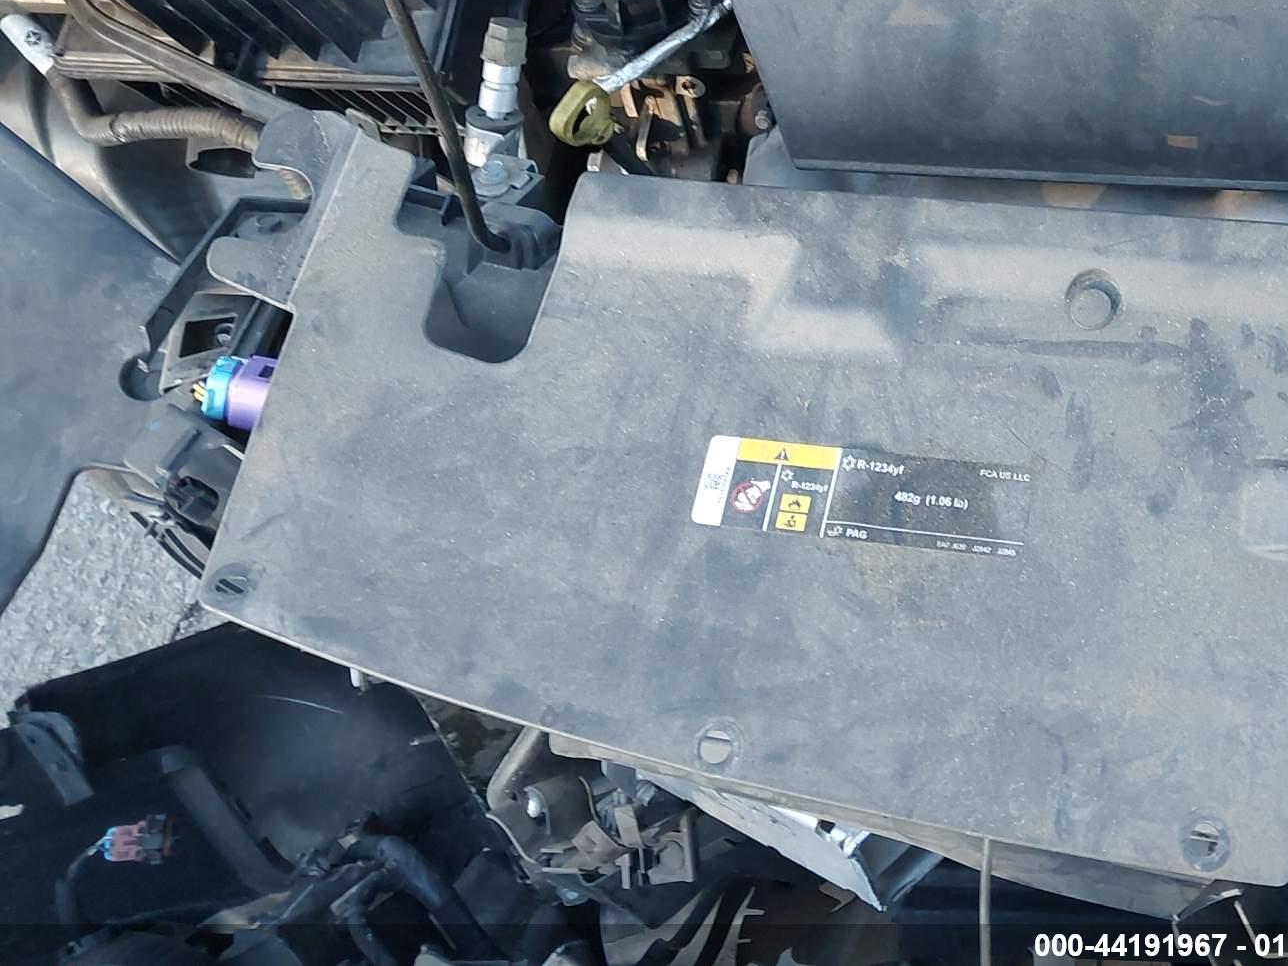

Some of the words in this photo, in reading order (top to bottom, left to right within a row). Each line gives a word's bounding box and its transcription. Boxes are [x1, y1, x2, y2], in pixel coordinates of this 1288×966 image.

[855, 456, 905, 477] R-1234yf
[979, 468, 998, 479] FCA
[998, 470, 1012, 481] US
[1013, 472, 1032, 483] LLC
[894, 491, 922, 506] 482g
[925, 493, 952, 508] (1.06
[845, 527, 868, 540] PAG
